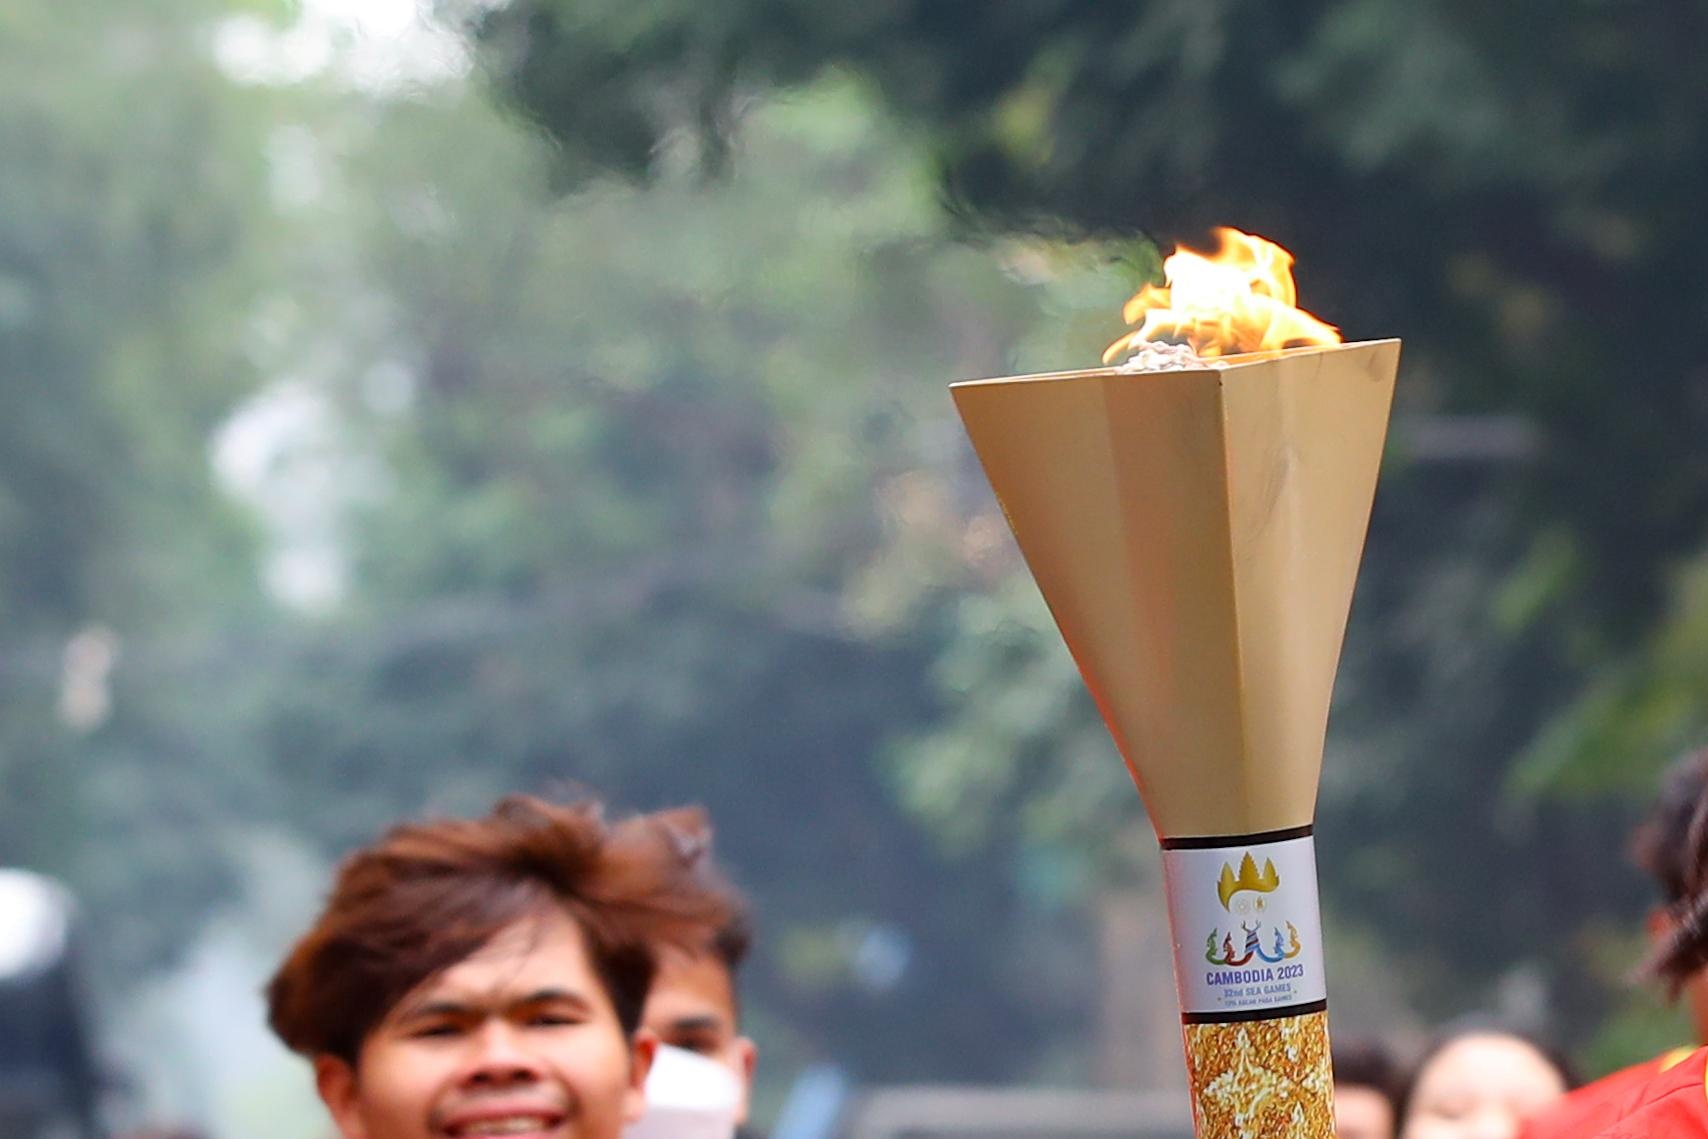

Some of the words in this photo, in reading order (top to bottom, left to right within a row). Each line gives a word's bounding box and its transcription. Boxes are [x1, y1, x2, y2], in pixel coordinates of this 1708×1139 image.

[1206, 968, 1274, 985] CAMBODIA
[1277, 964, 1304, 980] 2023
[1245, 987, 1262, 996] SEA
[1264, 983, 1291, 995] GAMES
